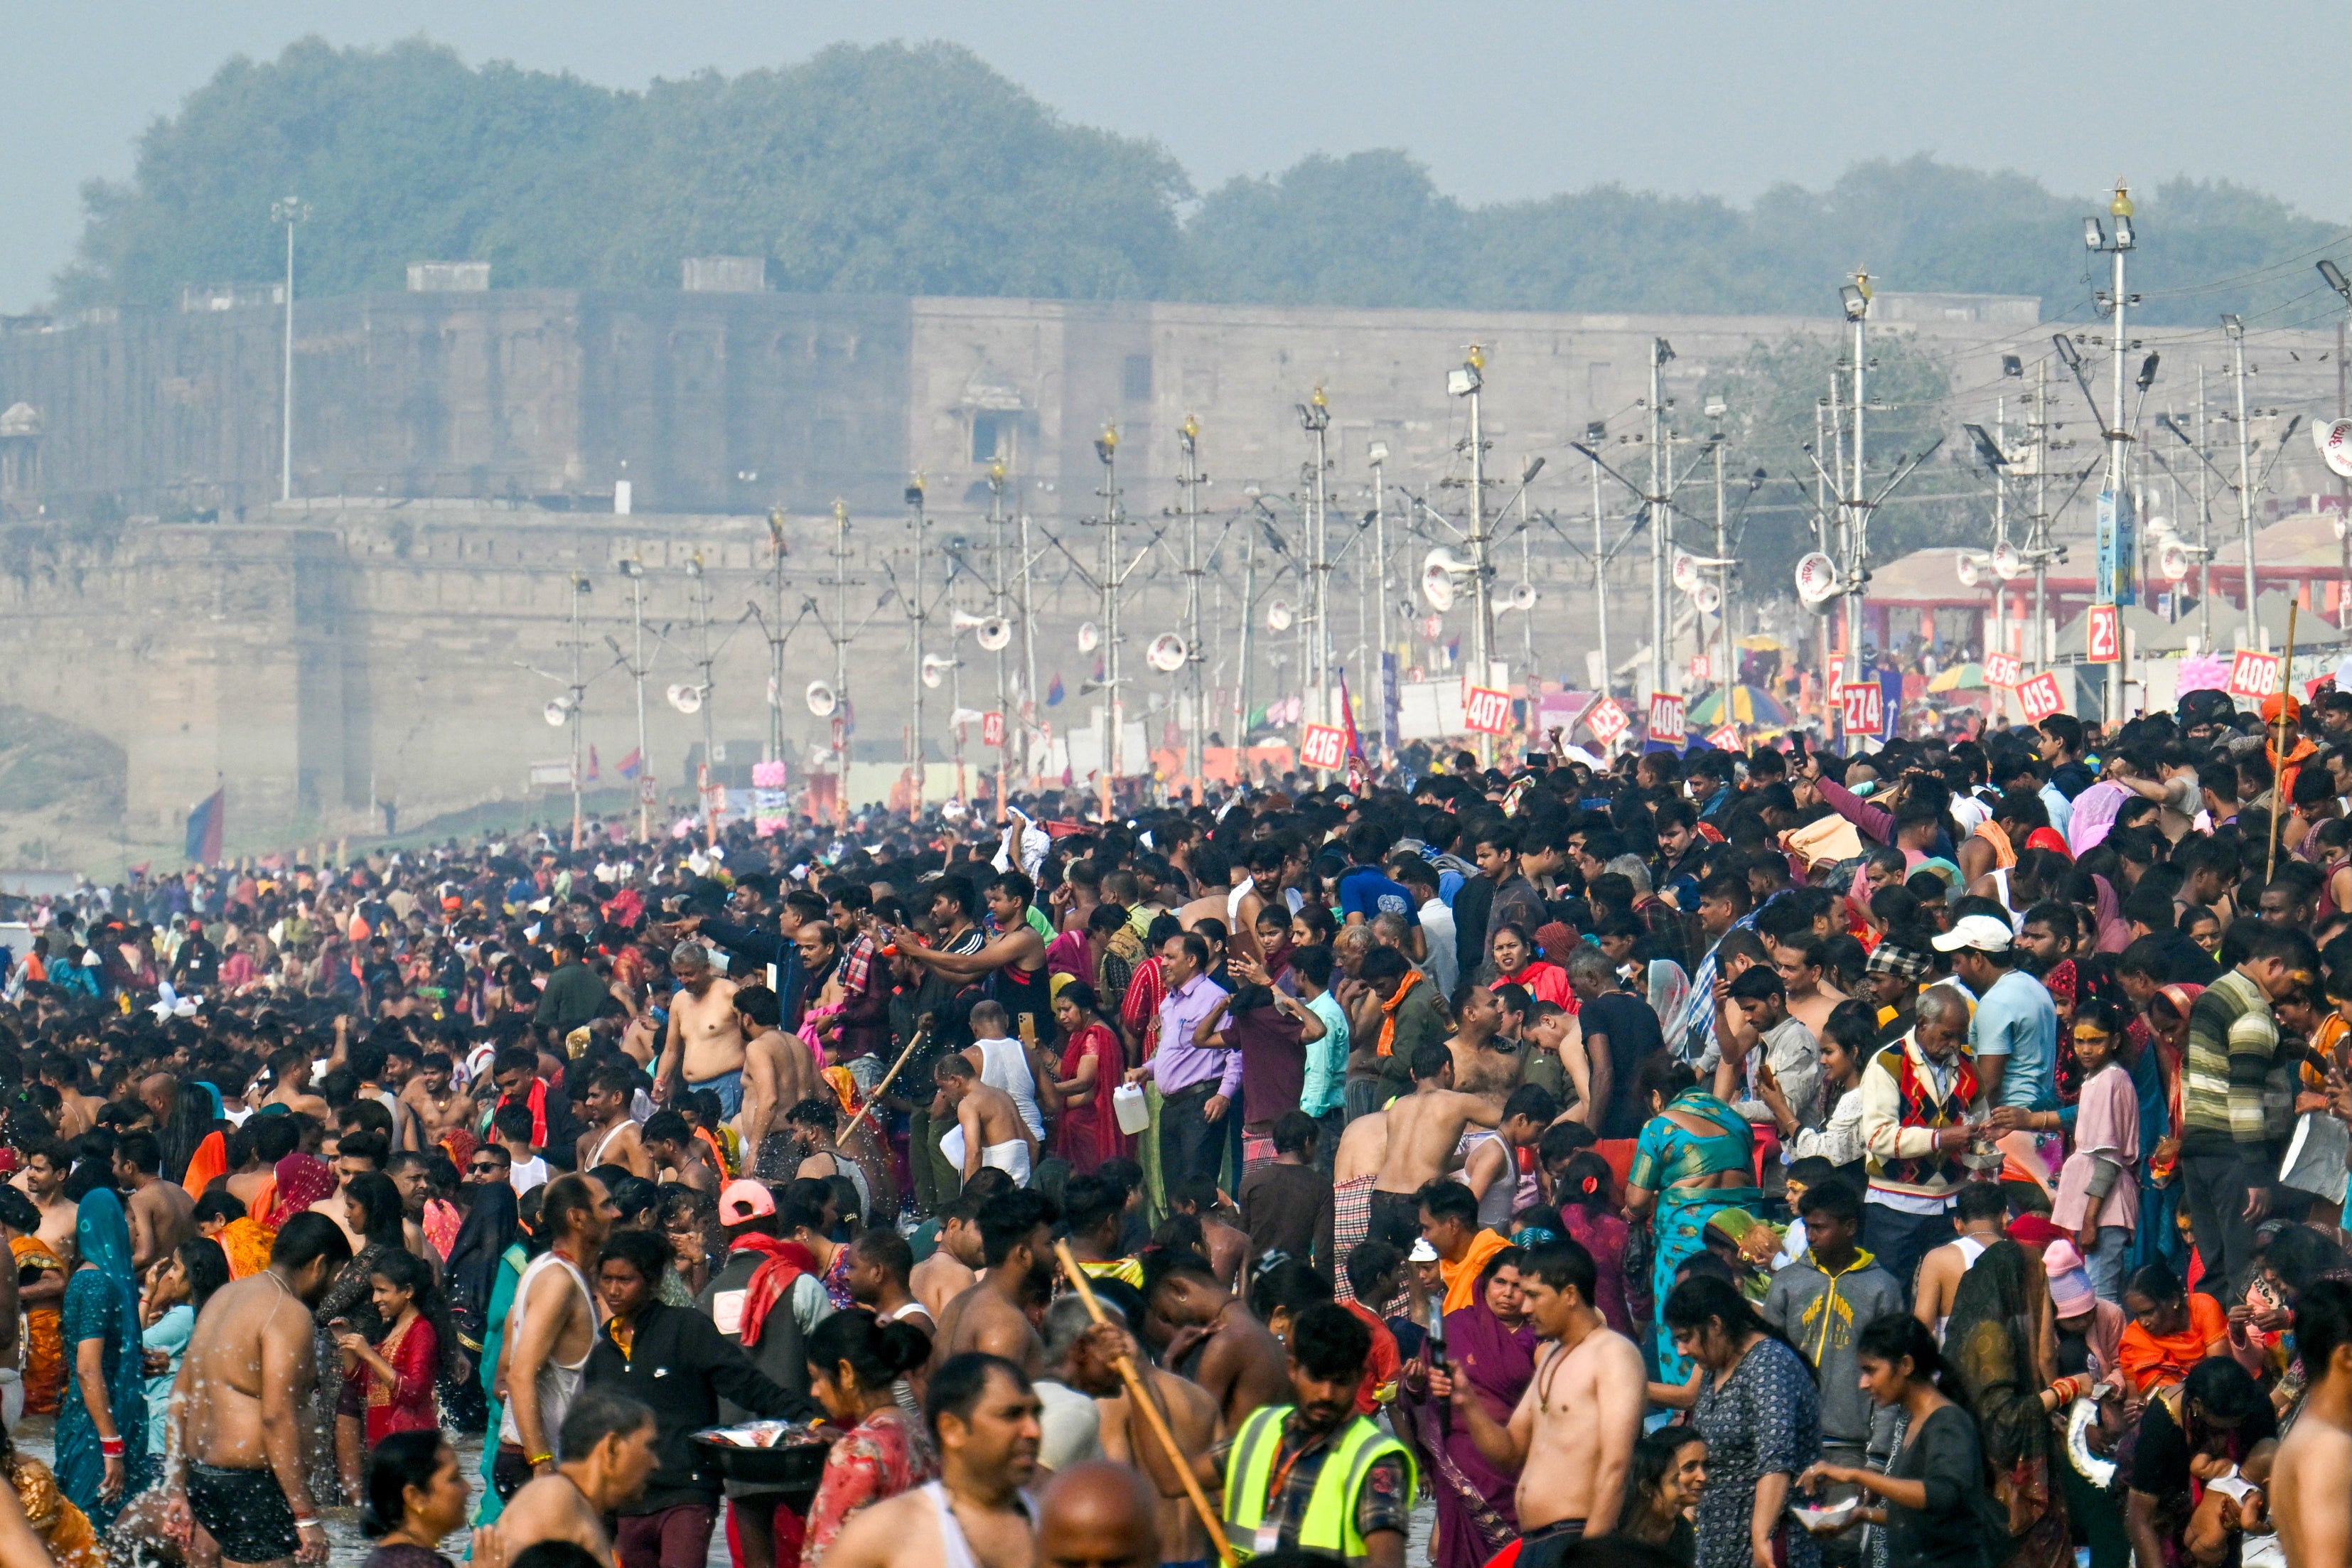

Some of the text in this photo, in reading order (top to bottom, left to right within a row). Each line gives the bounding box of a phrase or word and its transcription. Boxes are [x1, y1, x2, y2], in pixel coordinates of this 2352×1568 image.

[1986, 655, 2019, 686] 436
[2235, 656, 2277, 695] 408
[1468, 692, 1508, 731] 407
[1845, 688, 1880, 729] 274
[2022, 677, 2058, 716] 415
[1590, 701, 1625, 737] 425
[1651, 698, 1684, 737] 406
[1304, 729, 1339, 766] 416
